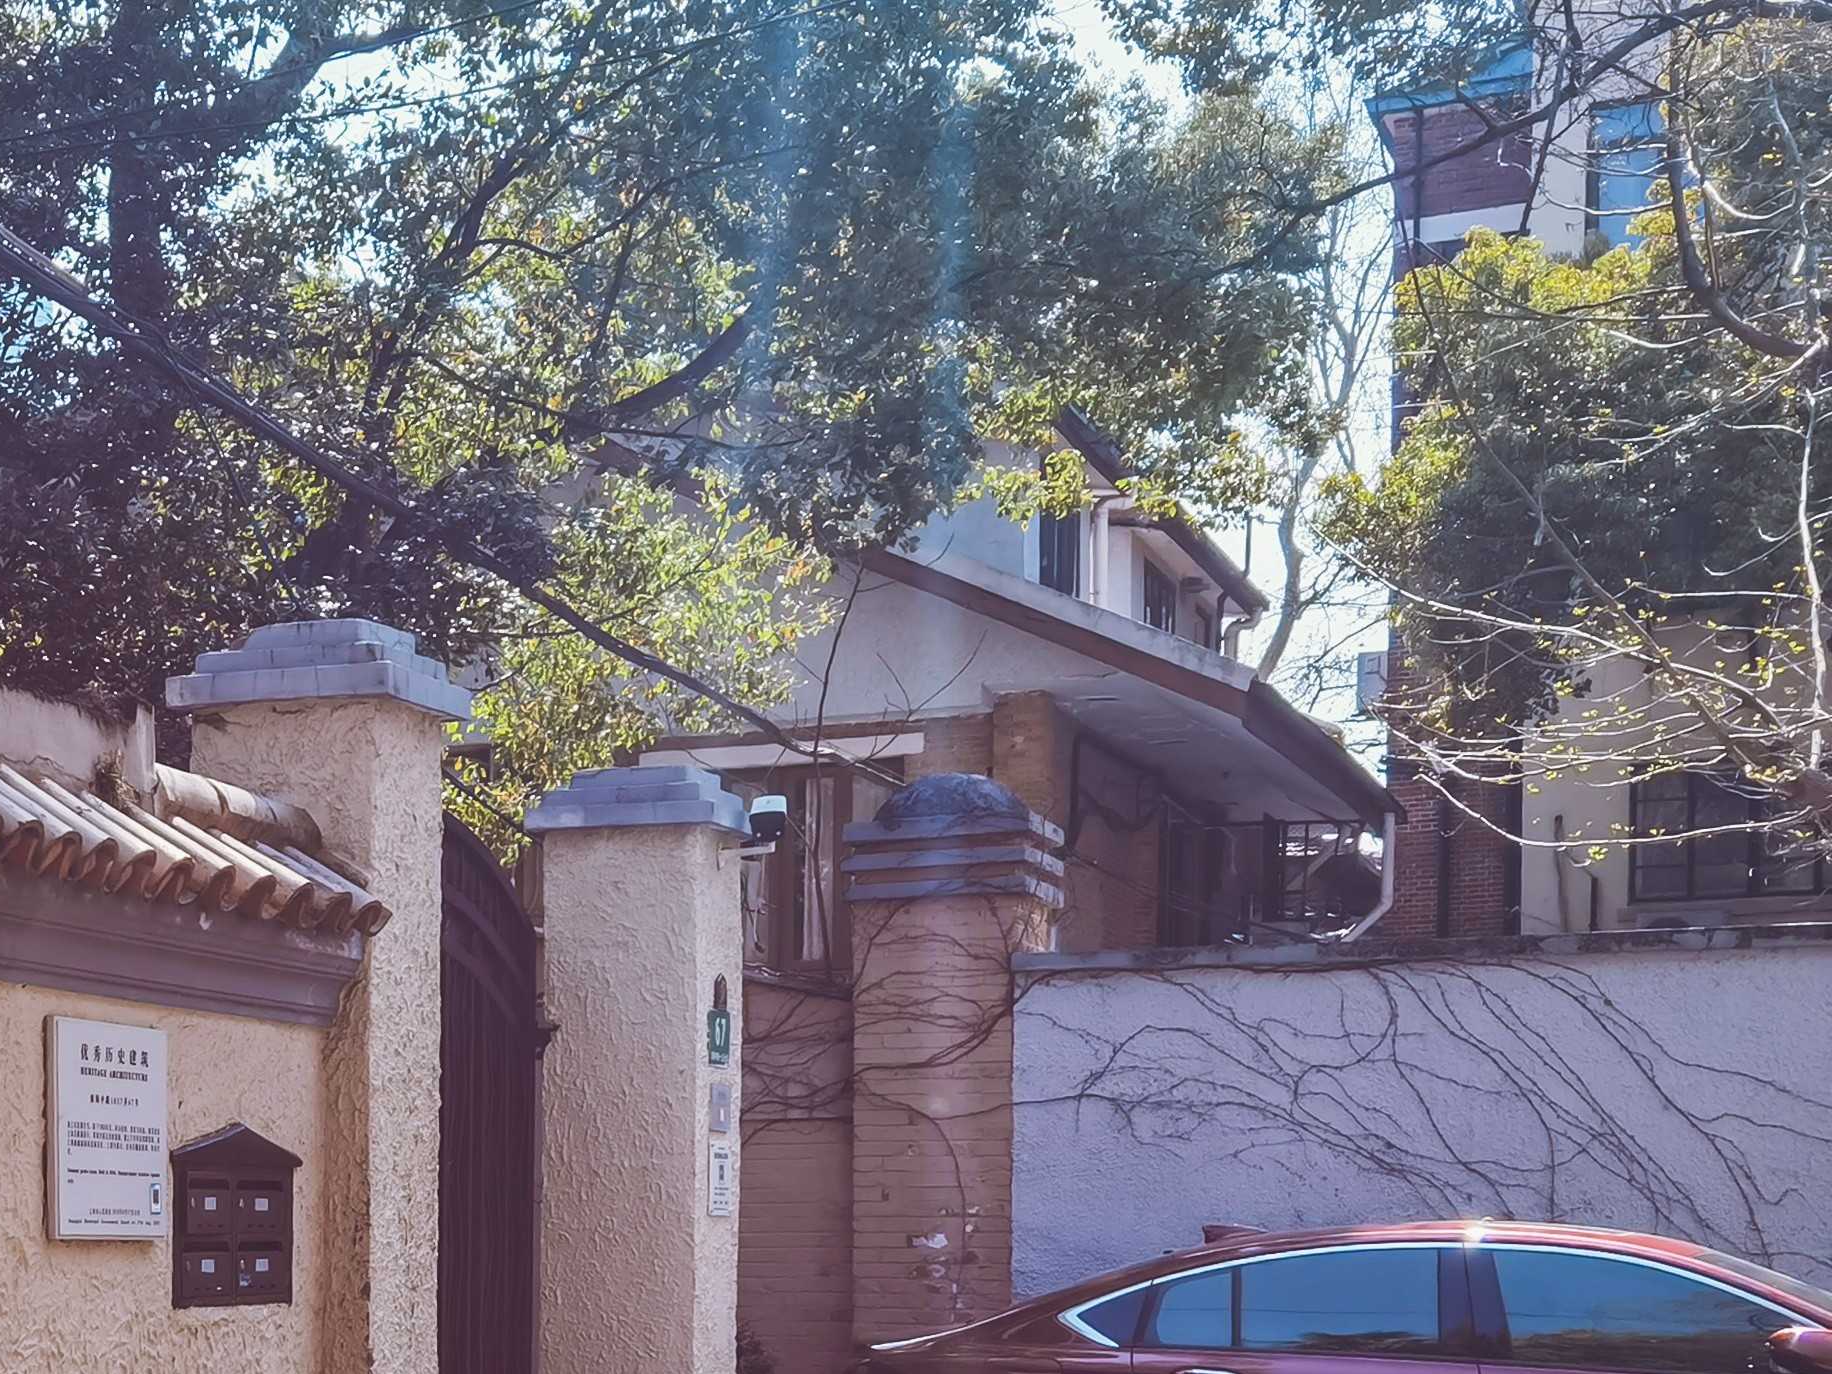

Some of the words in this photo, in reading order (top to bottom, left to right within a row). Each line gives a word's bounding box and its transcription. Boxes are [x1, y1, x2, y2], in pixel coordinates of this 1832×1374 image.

[714, 1016, 726, 1047] 67
[80, 1043, 149, 1068] 优秀历史建筑
[80, 1066, 107, 1078] HERITAGE
